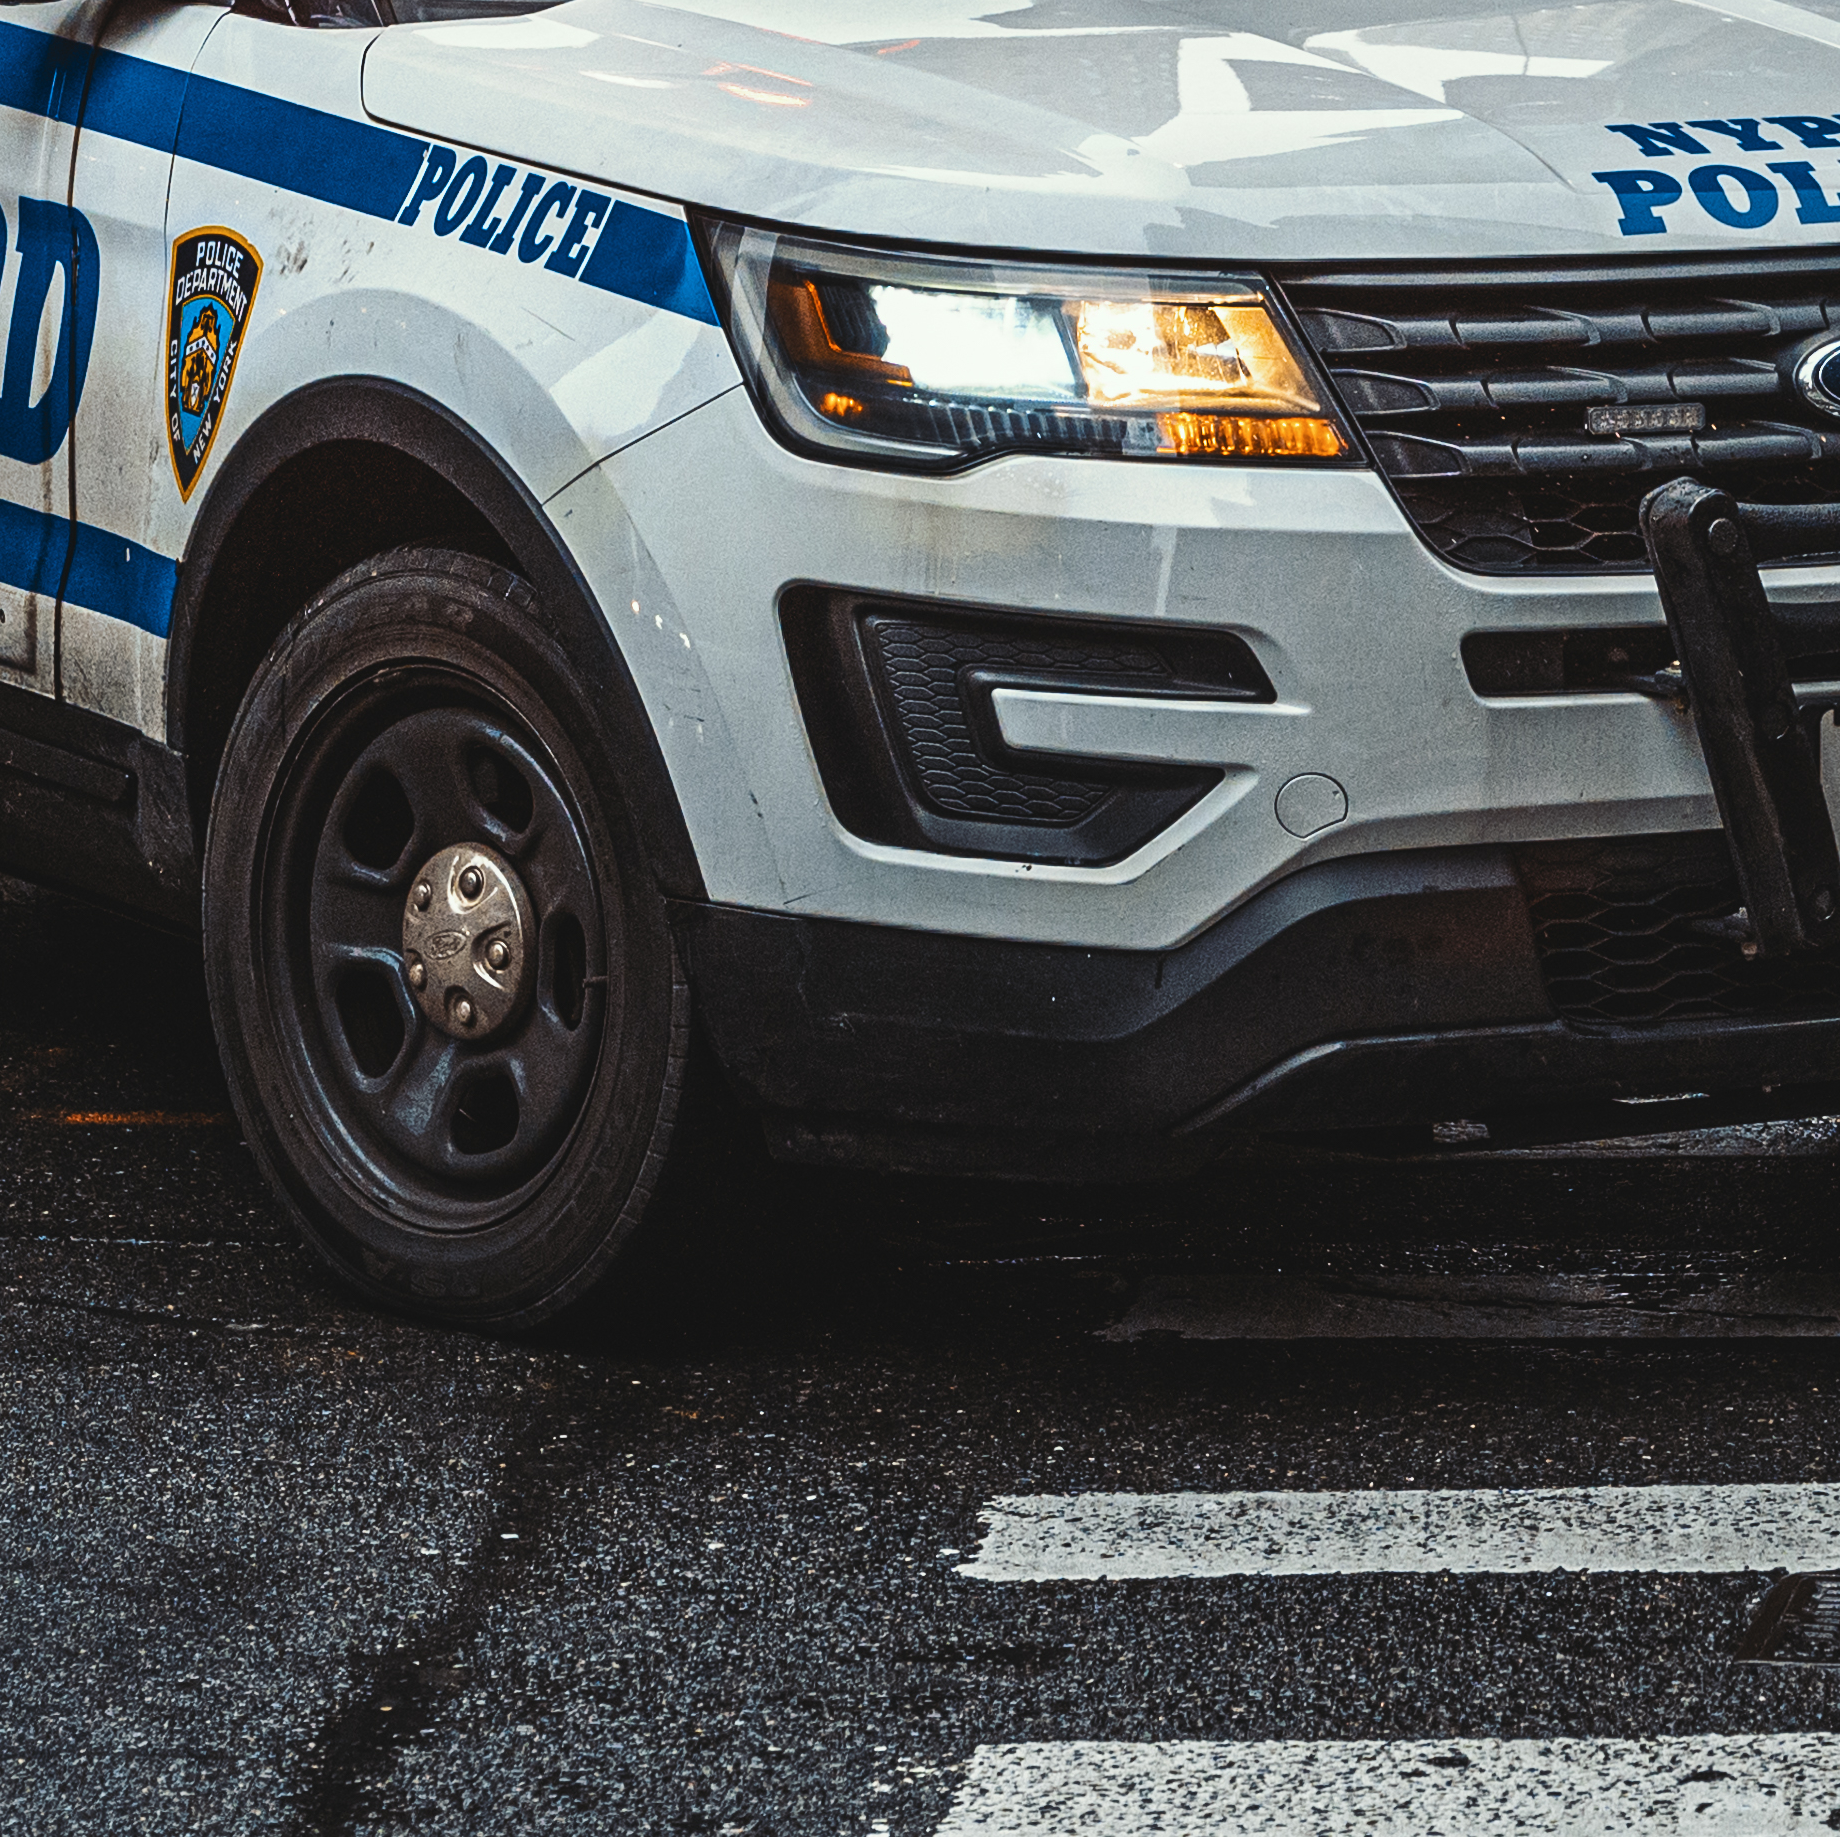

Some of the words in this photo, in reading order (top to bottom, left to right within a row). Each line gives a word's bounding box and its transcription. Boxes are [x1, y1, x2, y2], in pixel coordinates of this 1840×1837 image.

[397, 143, 612, 279] POLICE
[195, 240, 244, 280] POLICE
[175, 267, 248, 323] DEPARTMENT
[169, 339, 179, 400] CITY
[212, 339, 237, 404] YORK
[170, 412, 181, 444] OF
[192, 413, 213, 465] NEW
